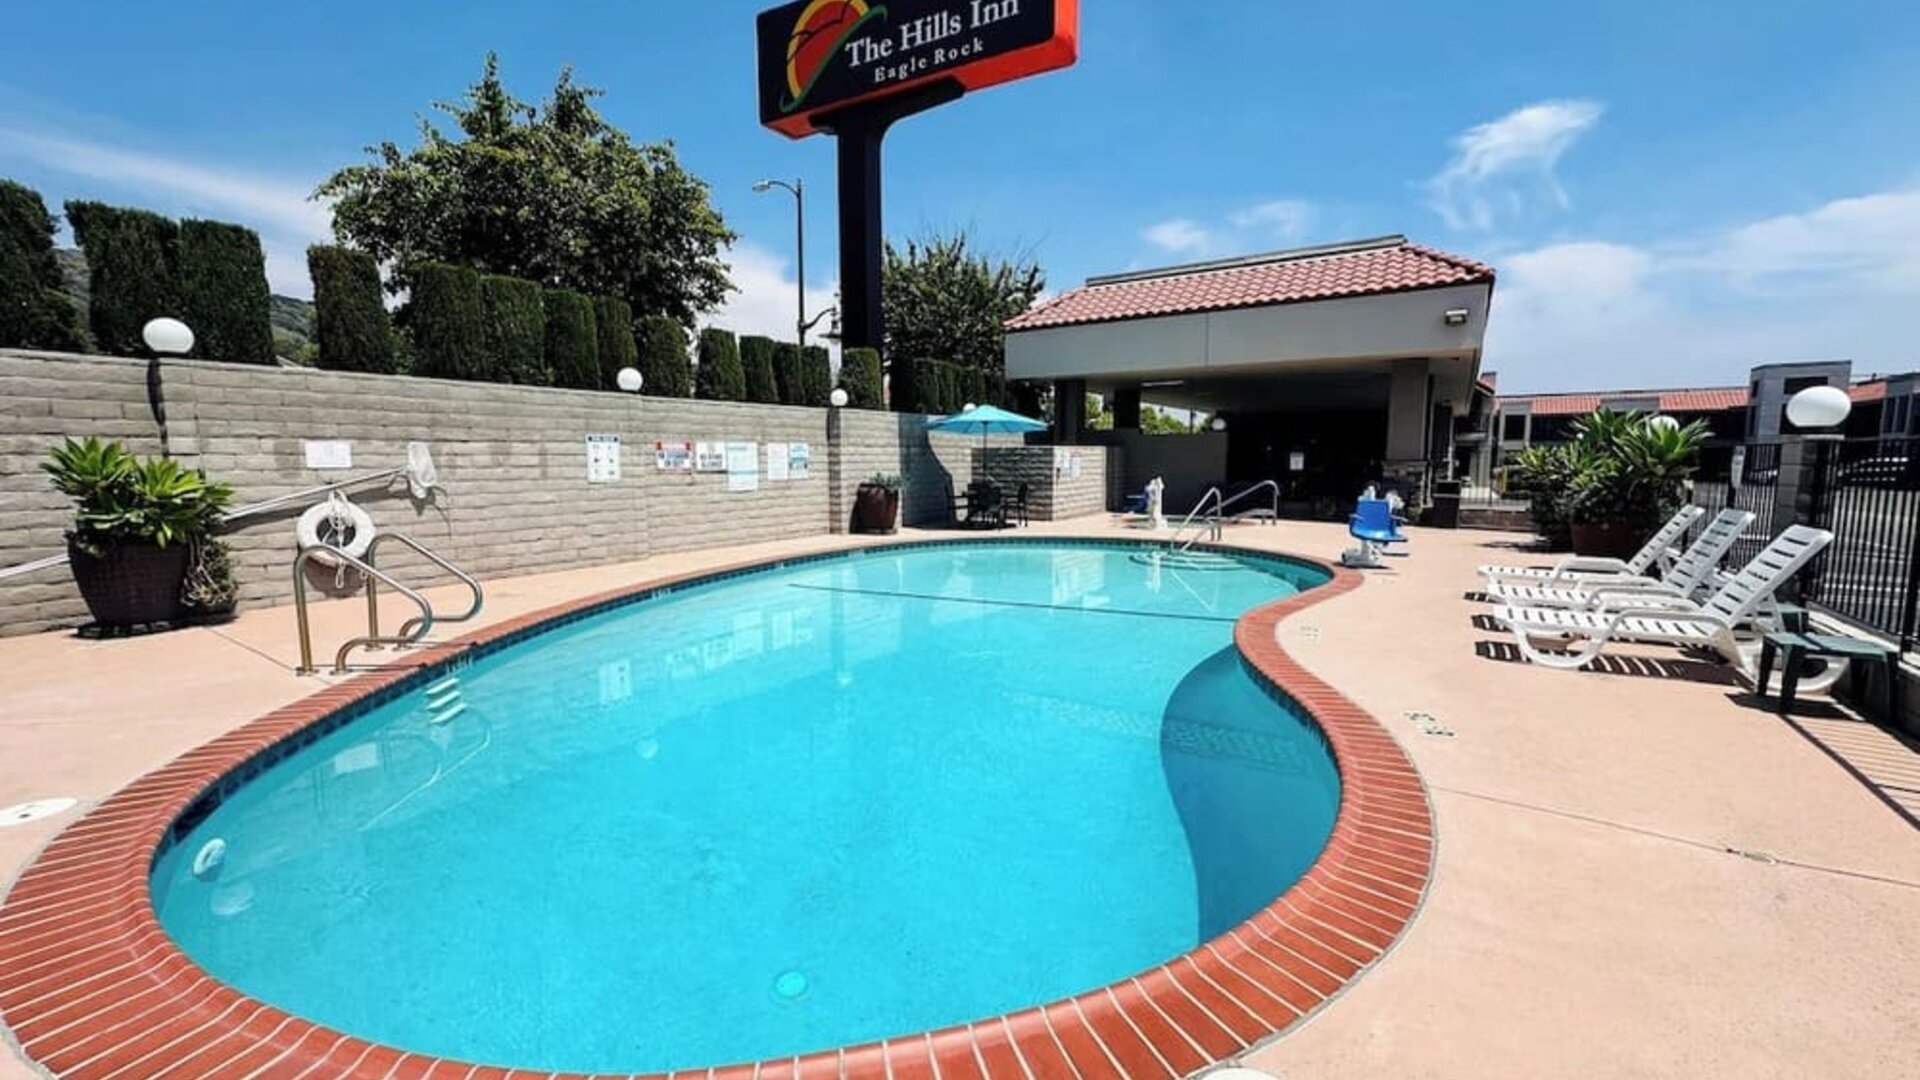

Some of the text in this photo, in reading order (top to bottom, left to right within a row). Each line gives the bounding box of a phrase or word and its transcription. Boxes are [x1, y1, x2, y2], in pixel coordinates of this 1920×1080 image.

[845, 0, 1019, 68] The Hills Inn
[874, 37, 984, 83] Eagle Rock
